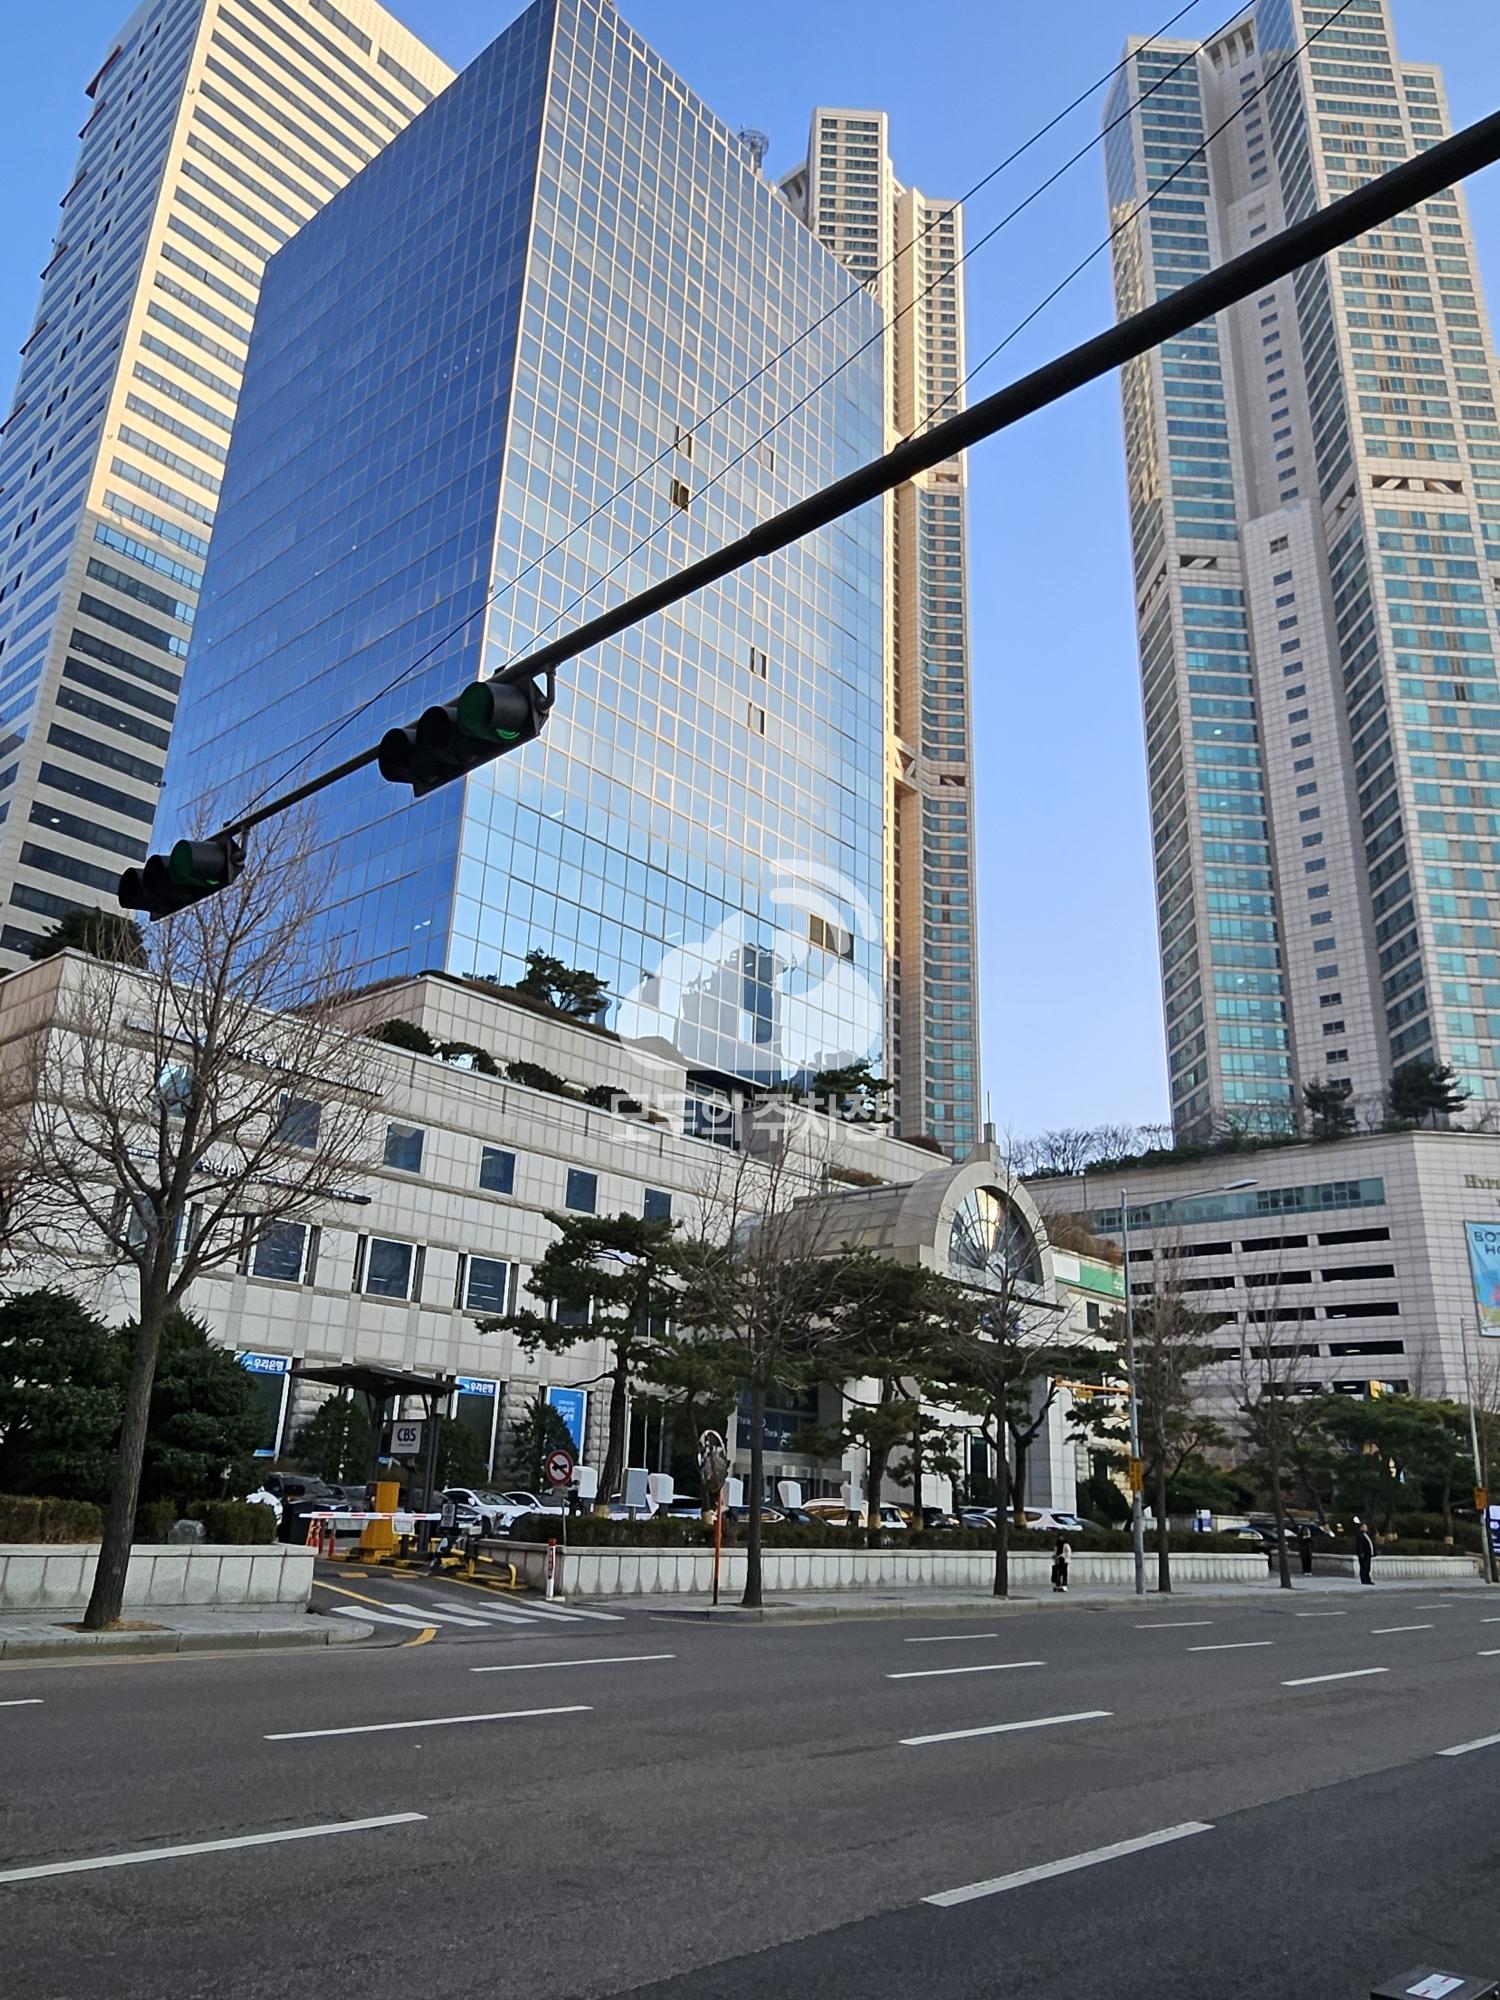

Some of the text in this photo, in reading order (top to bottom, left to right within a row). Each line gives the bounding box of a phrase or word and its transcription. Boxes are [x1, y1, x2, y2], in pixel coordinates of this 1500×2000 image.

[254, 1358, 284, 1371] 우리은행
[470, 1382, 494, 1394] 우리은행
[397, 1427, 417, 1442] CBS
